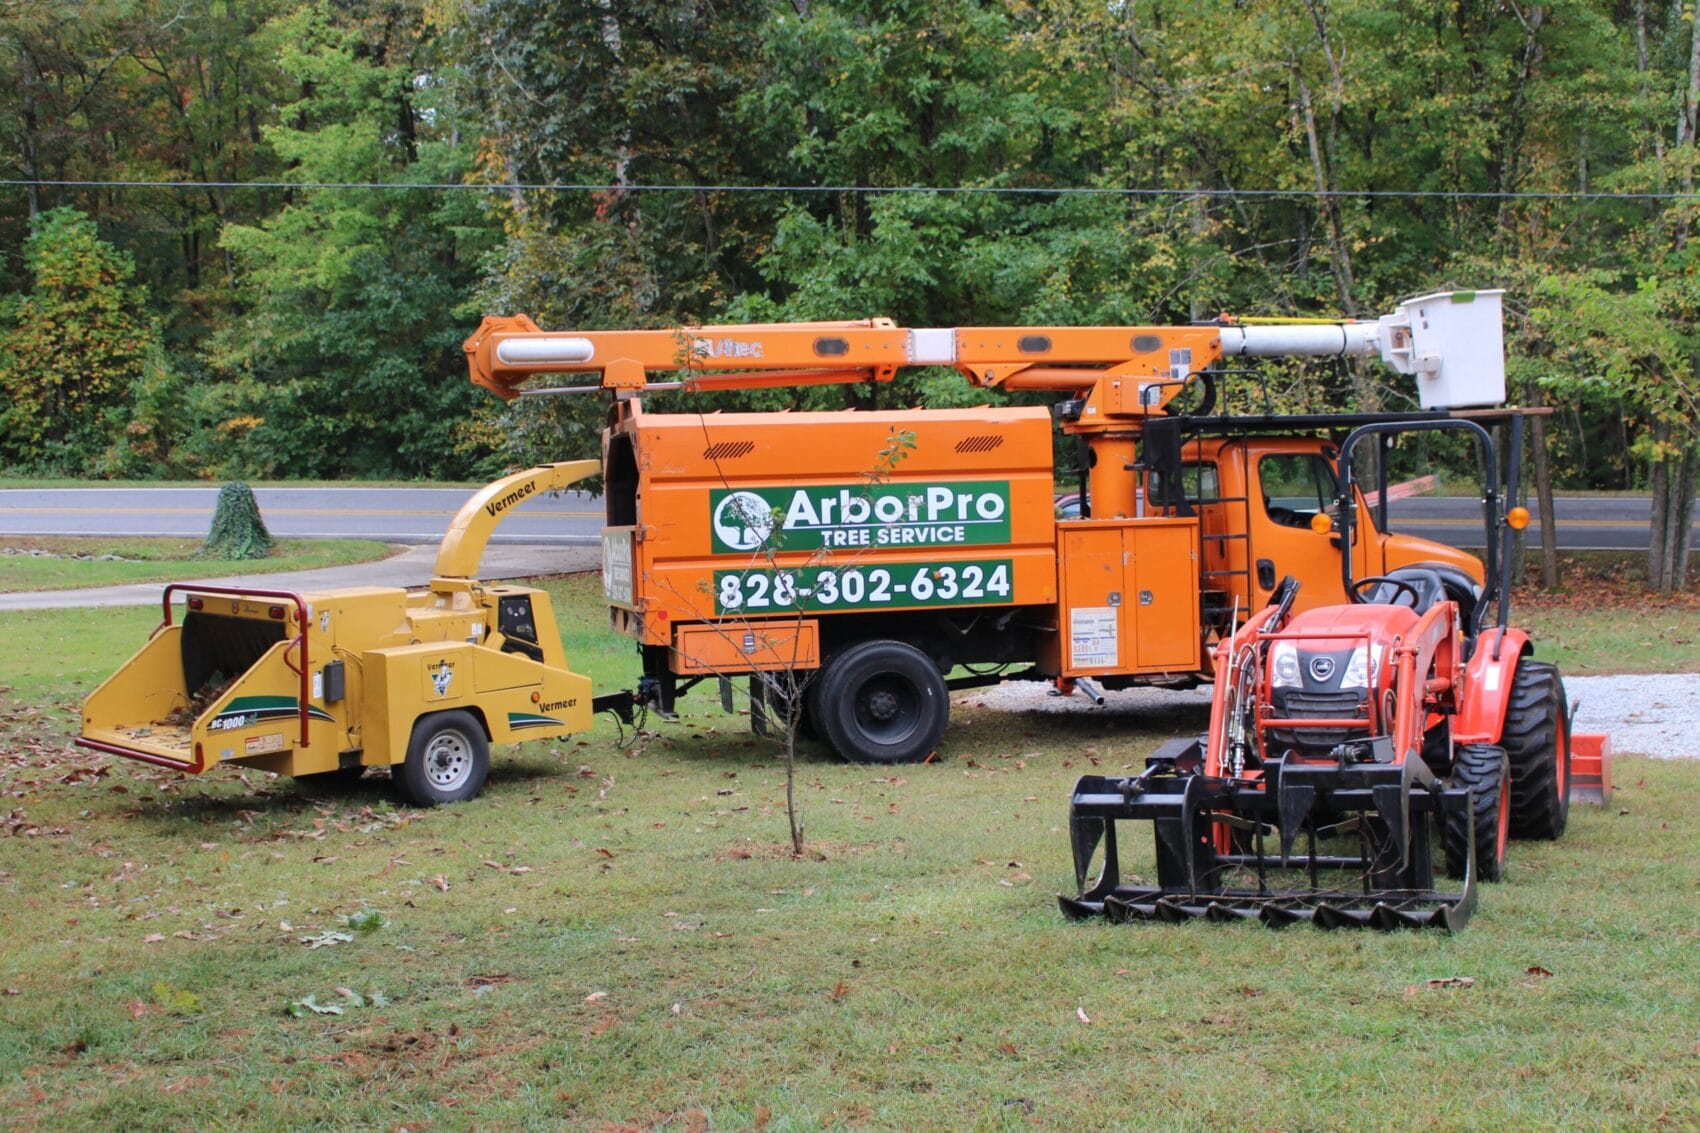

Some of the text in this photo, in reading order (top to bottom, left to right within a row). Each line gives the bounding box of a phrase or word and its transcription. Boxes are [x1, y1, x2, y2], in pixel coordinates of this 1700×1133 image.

[486, 480, 536, 517] Vermeer
[783, 487, 1005, 527] ArborPro
[821, 526, 965, 546] TREE SERVICE
[719, 565, 1010, 609] 828-302-6324
[539, 698, 577, 713] Vermeer
